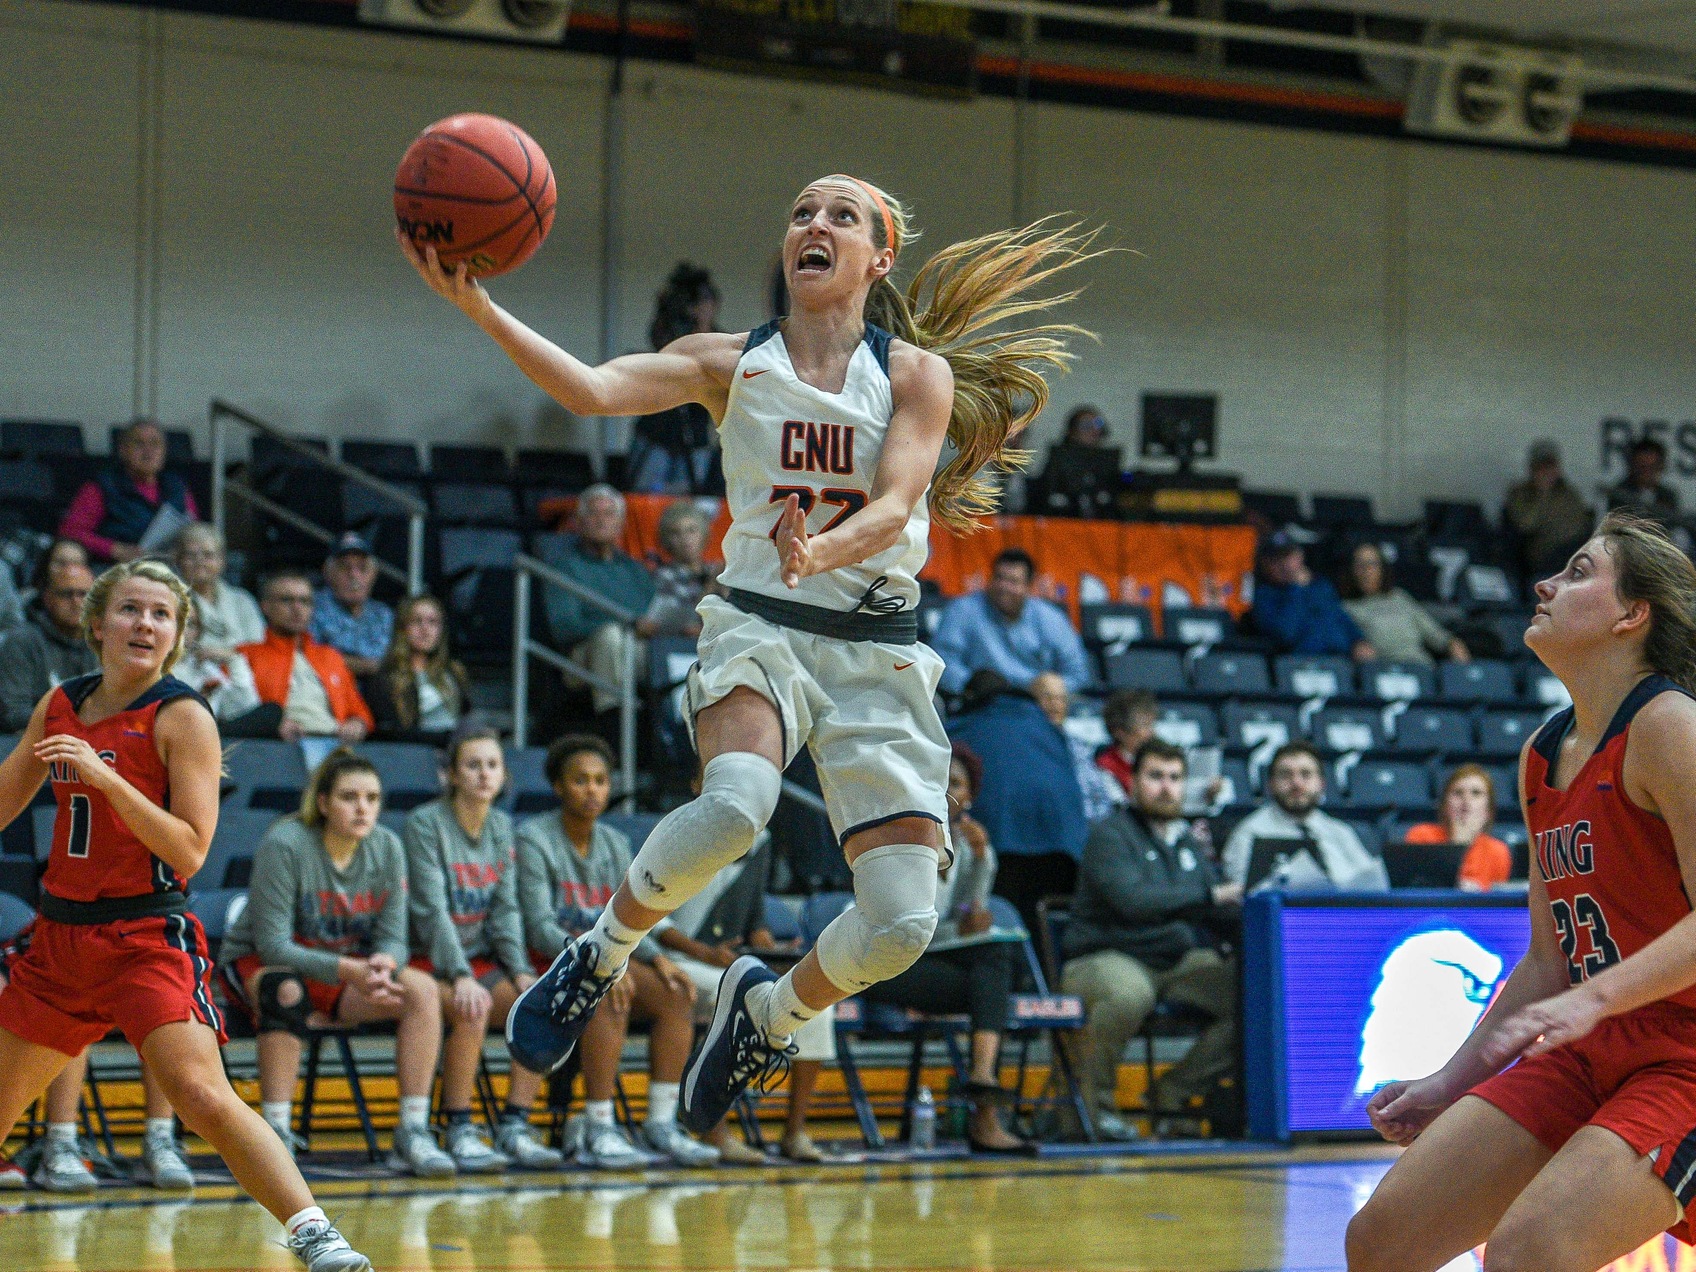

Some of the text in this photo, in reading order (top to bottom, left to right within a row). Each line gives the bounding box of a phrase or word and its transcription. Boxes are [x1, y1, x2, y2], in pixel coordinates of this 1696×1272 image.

[780, 420, 854, 475] CNU
[68, 794, 91, 859] 1
[1550, 893, 1622, 987] 23
